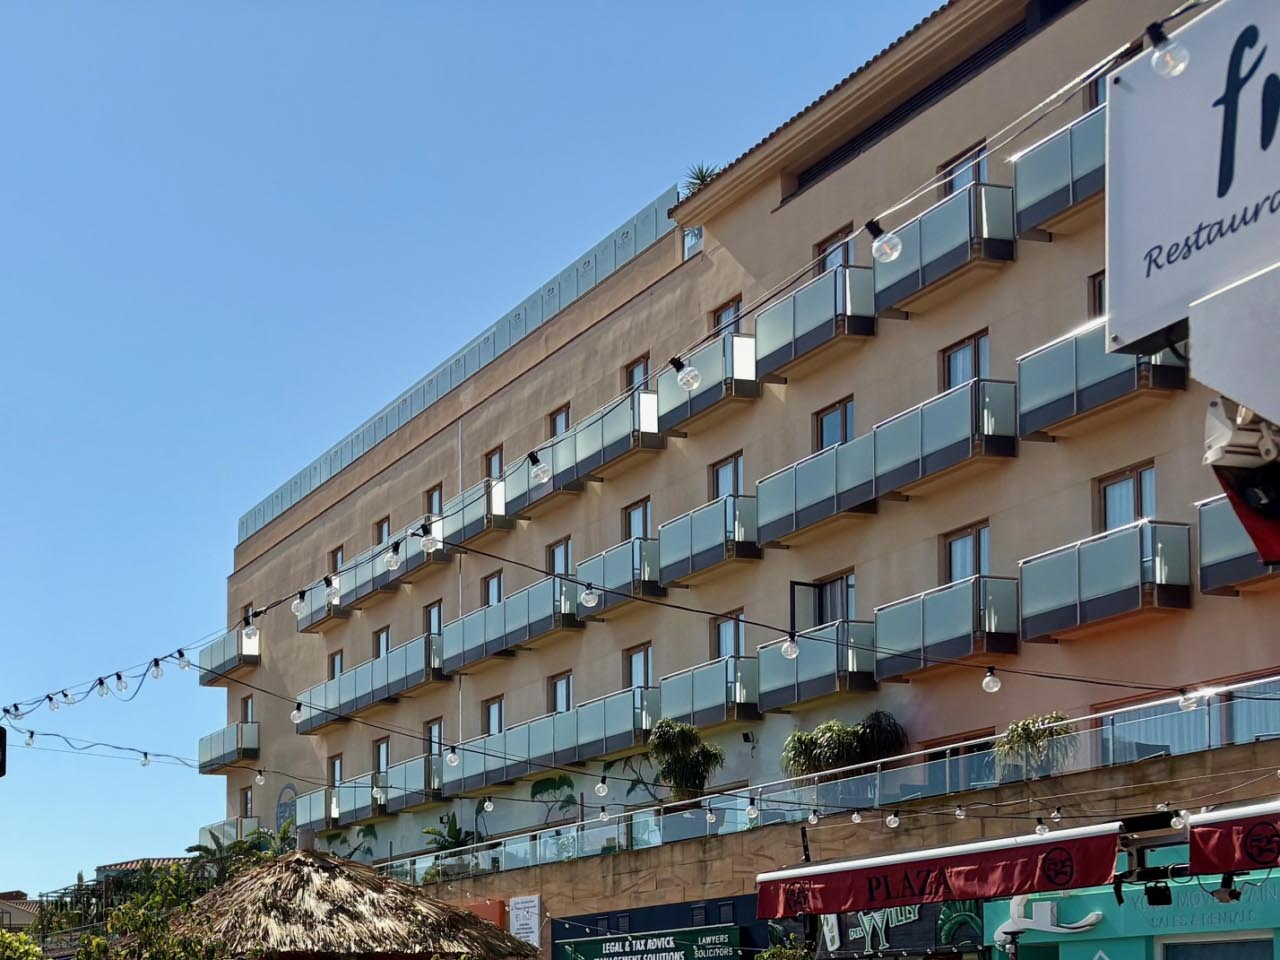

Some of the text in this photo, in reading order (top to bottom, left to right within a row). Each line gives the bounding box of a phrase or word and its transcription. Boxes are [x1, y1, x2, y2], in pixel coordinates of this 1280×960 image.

[867, 867, 954, 902] PLAZA
[698, 935, 729, 945] LAWYERS
[848, 926, 864, 941] DEL
[602, 937, 675, 954] LEGAL & TAX ADVICE
[694, 947, 733, 958] SOLICITORS
